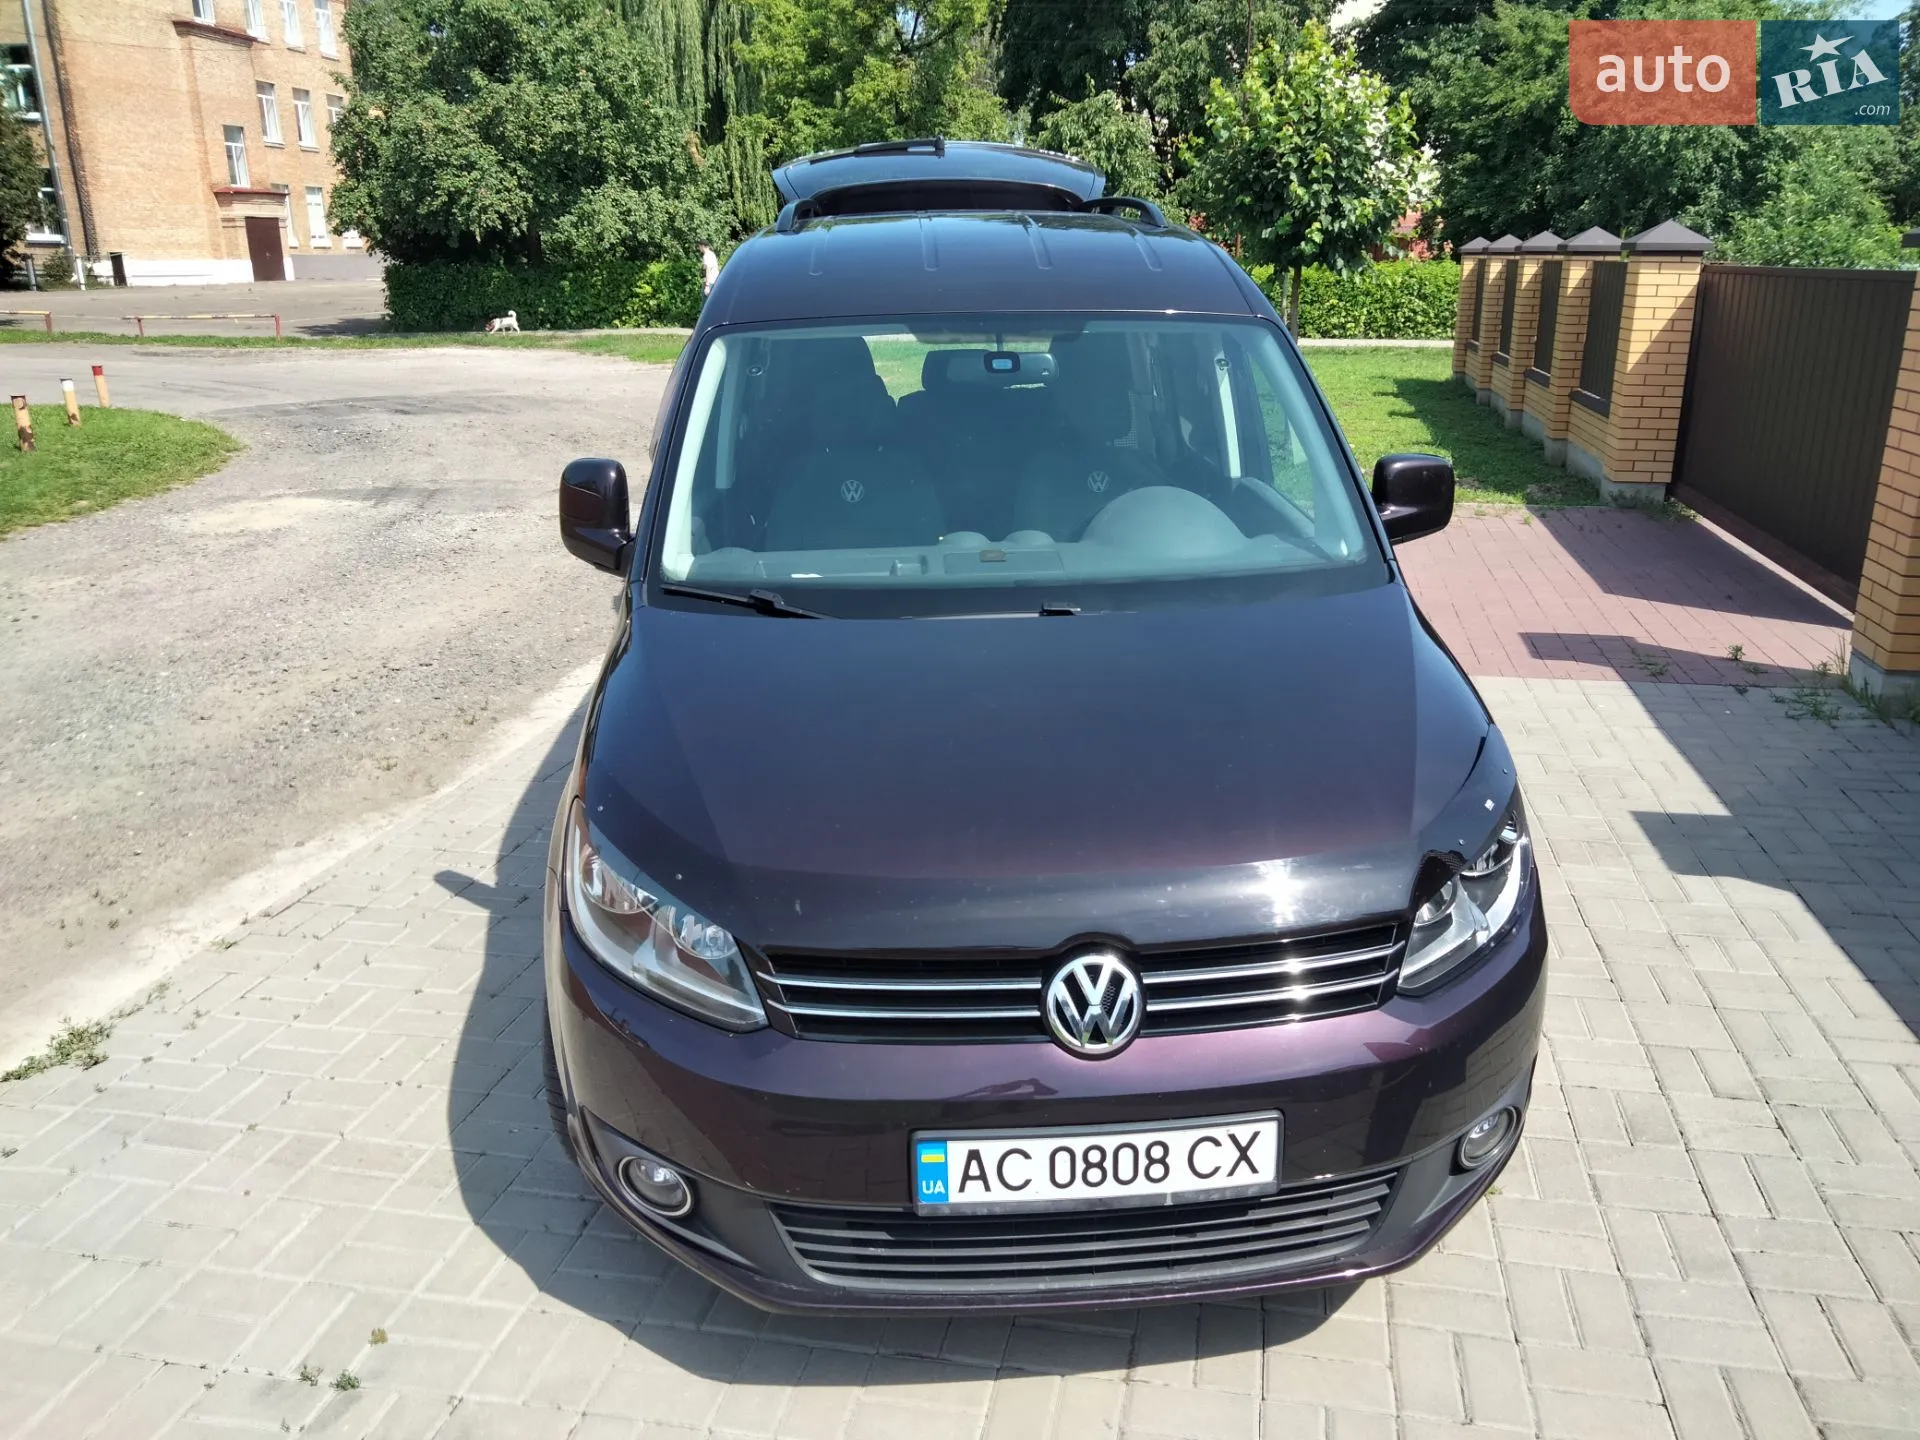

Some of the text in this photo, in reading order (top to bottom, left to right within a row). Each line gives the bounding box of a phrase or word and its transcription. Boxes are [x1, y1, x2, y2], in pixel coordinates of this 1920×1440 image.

[1047, 956, 1140, 1054] VW
[922, 1180, 946, 1195] UA
[958, 1130, 1262, 1193] AC 0808 CX
